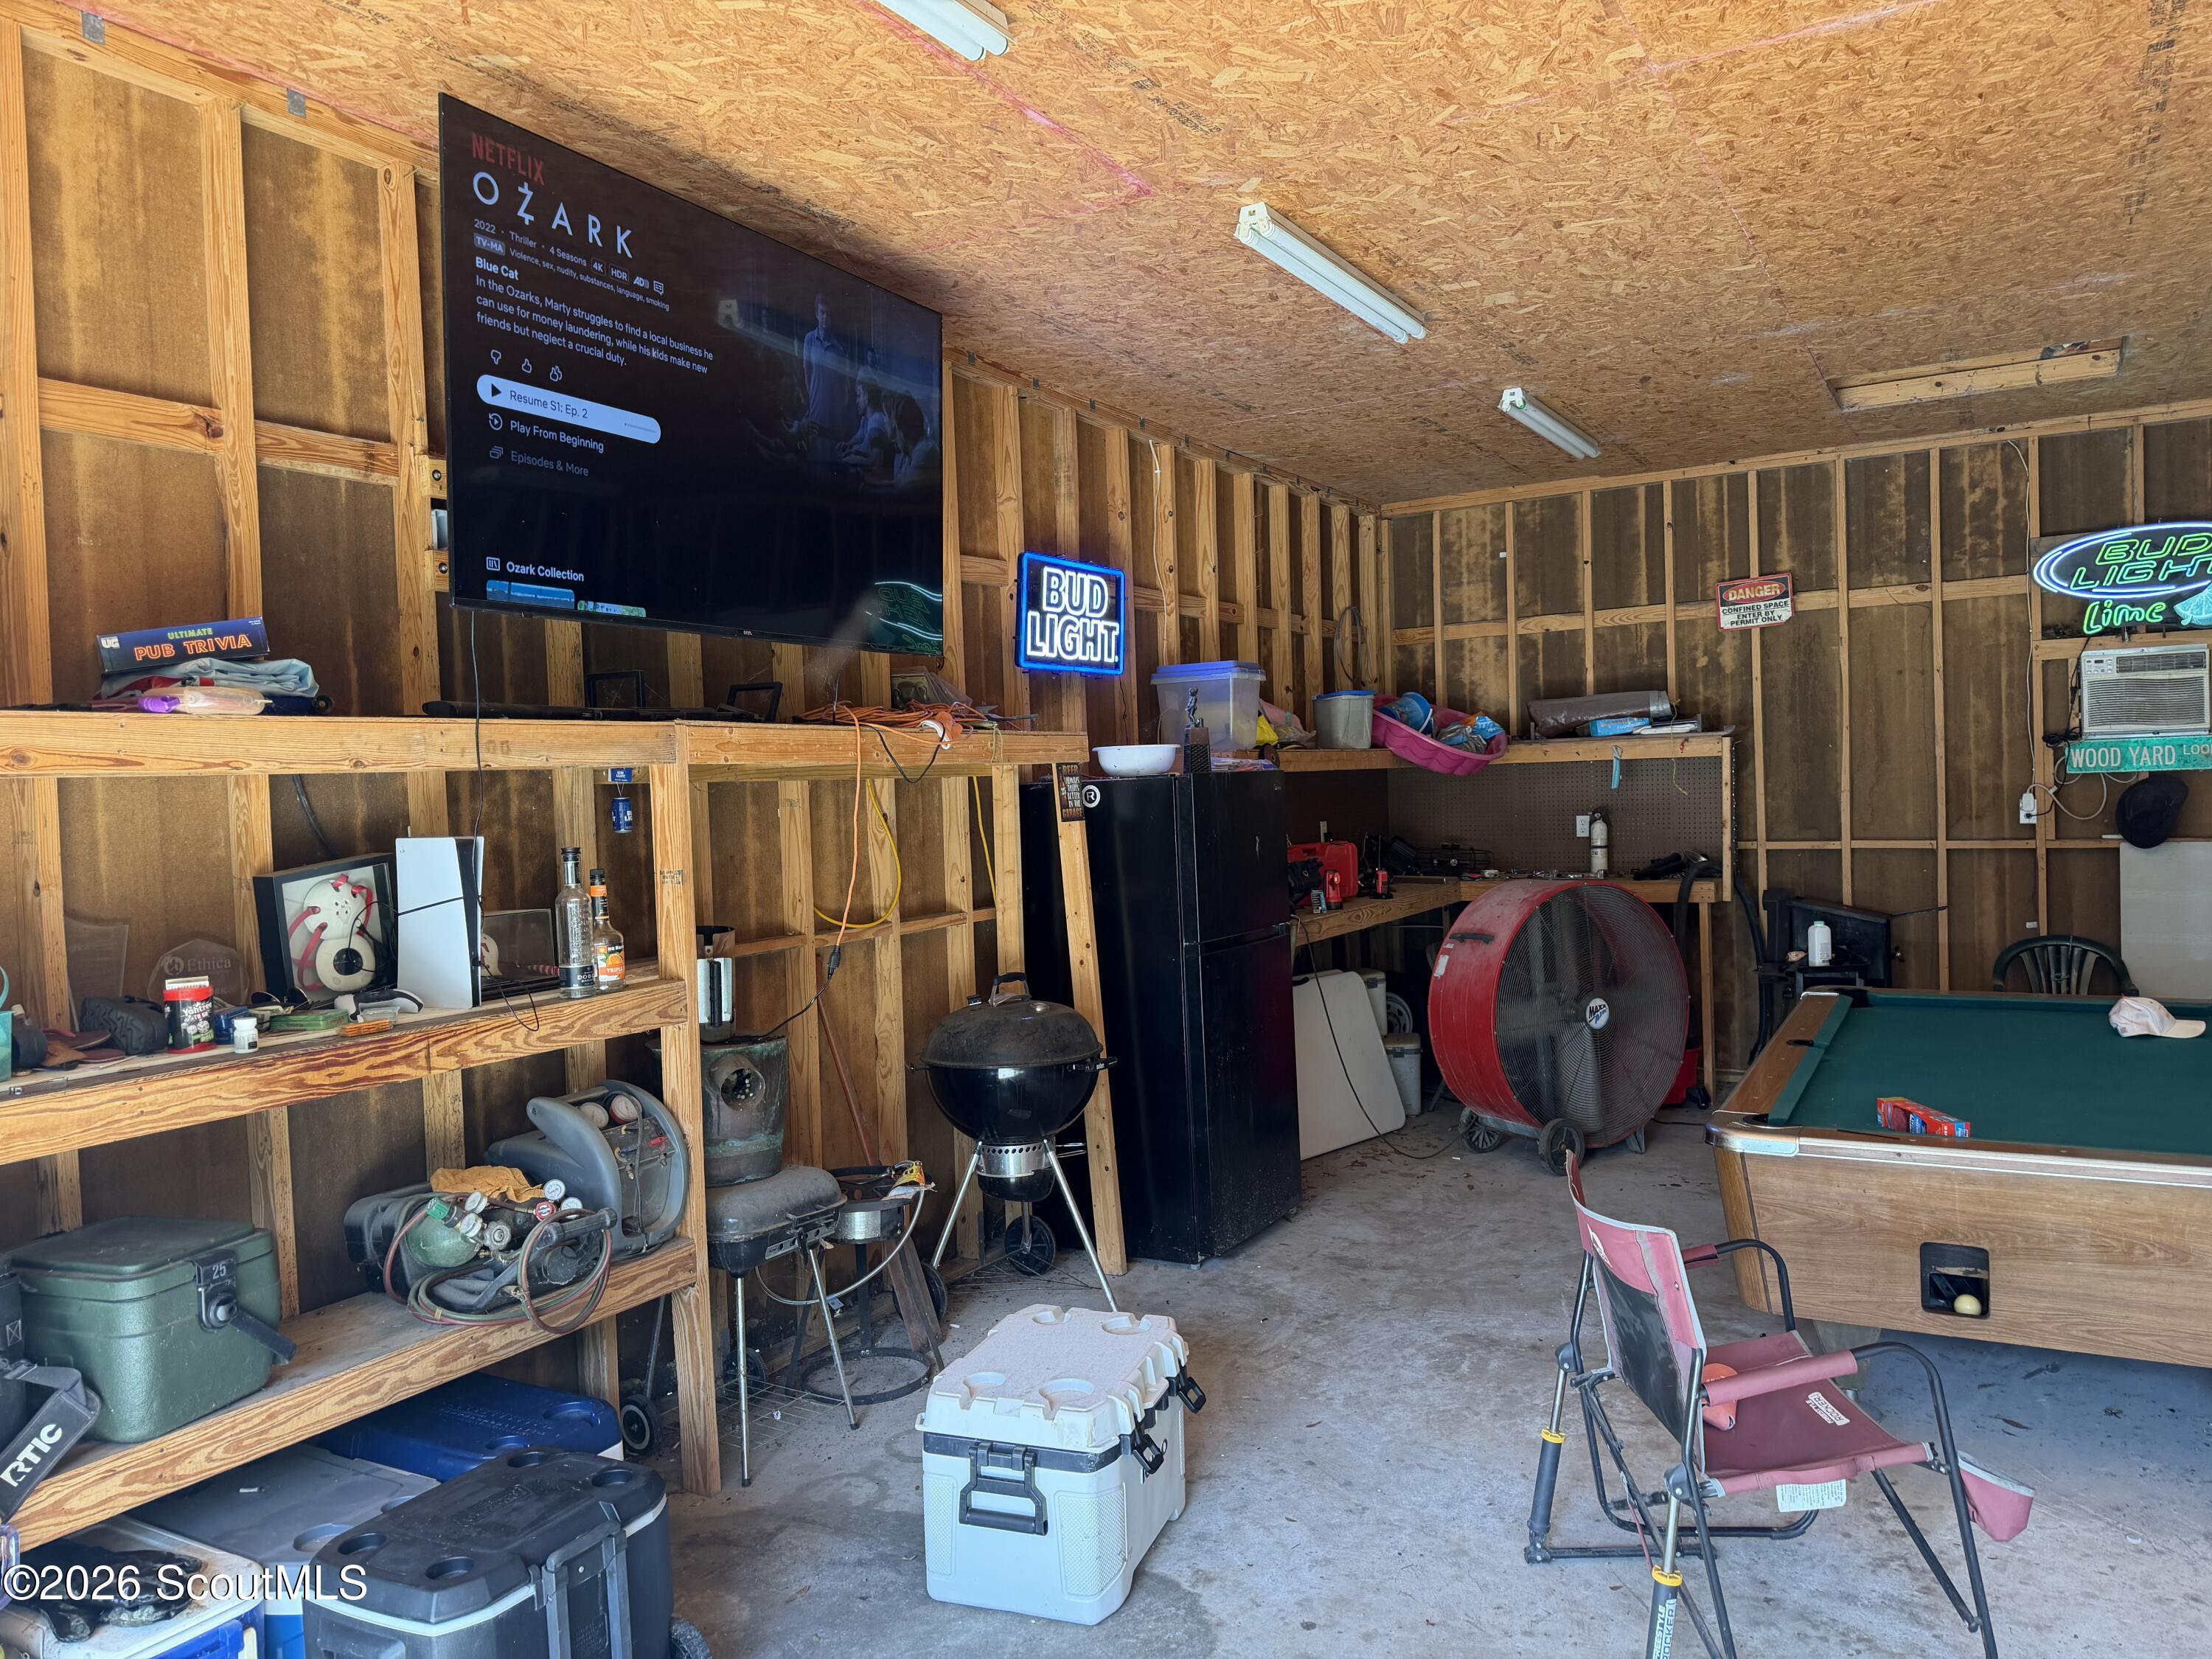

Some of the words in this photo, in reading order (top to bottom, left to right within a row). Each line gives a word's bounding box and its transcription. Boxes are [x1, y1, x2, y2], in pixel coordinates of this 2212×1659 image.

[472, 133, 544, 185] NETFLIX
[474, 219, 496, 234] 2022
[509, 231, 537, 248] Thriller
[549, 246, 555, 255] 4
[557, 248, 587, 266] Seasons
[592, 261, 603, 273] 4K
[611, 267, 627, 281] HDR
[476, 257, 498, 274] Blue
[501, 265, 518, 280] Cat
[476, 236, 504, 253] TV-MA
[509, 248, 541, 267] Violence,
[542, 260, 556, 272] sex,
[557, 265, 578, 280] nudity,
[580, 273, 616, 293] substances,
[616, 286, 645, 303] language,
[646, 296, 669, 312] smoking
[476, 275, 486, 288] In
[488, 279, 504, 293] the
[507, 285, 542, 307] Ozarks,
[545, 297, 571, 318] Marty
[573, 307, 613, 330] struggles
[615, 319, 623, 332] to
[625, 323, 641, 338] find
[643, 330, 648, 338] a
[650, 329, 667, 344] local
[669, 338, 702, 358] business
[704, 348, 713, 361] he
[476, 295, 495, 310] can
[497, 301, 514, 315] use
[517, 304, 530, 319] for
[532, 312, 563, 332] money
[566, 321, 613, 347] laundering,
[616, 336, 637, 352] while
[639, 343, 650, 357] his
[653, 347, 668, 362] kids
[670, 353, 691, 369] make
[692, 361, 707, 374] new
[476, 312, 511, 332] friends
[514, 322, 529, 337] but
[532, 329, 566, 351] neglect
[568, 341, 574, 350] a
[575, 341, 604, 359] crucial
[606, 349, 627, 367] duty.
[510, 389, 547, 409] Resume
[550, 400, 563, 414] S1:
[566, 404, 580, 420] Ep.
[582, 408, 588, 419] 2
[510, 420, 531, 437] Play
[533, 425, 557, 441] From
[560, 432, 604, 453] Beginning
[511, 451, 554, 470] Episodes
[556, 461, 563, 470] &
[566, 462, 588, 477] More
[2096, 532, 2212, 566] BUD
[507, 560, 535, 575] Ozark
[538, 564, 584, 582] Collection
[1042, 566, 1108, 618] BUD
[1728, 583, 1781, 602] DANGER
[1722, 604, 1761, 614] CONFINED
[1763, 600, 1789, 610] SPACE
[1731, 617, 1759, 627] PERMIT
[1761, 614, 1783, 623] ONLY
[1737, 611, 1763, 620] ENTER
[1764, 610, 1775, 618] BY
[2084, 599, 2166, 635] Lime
[133, 643, 175, 661] PUB
[183, 633, 252, 655] TRIVIA
[167, 627, 213, 640] ULTIMATE
[1062, 765, 1078, 774] BEER
[2071, 747, 2121, 768] WOOD
[2128, 745, 2176, 767] YARD
[2183, 744, 2212, 756] LOO
[187, 956, 232, 972] Ethica
[212, 1262, 226, 1280] 25
[1815, 1394, 1845, 1422] ROCKER
[0, 1424, 62, 1486] RTIC
